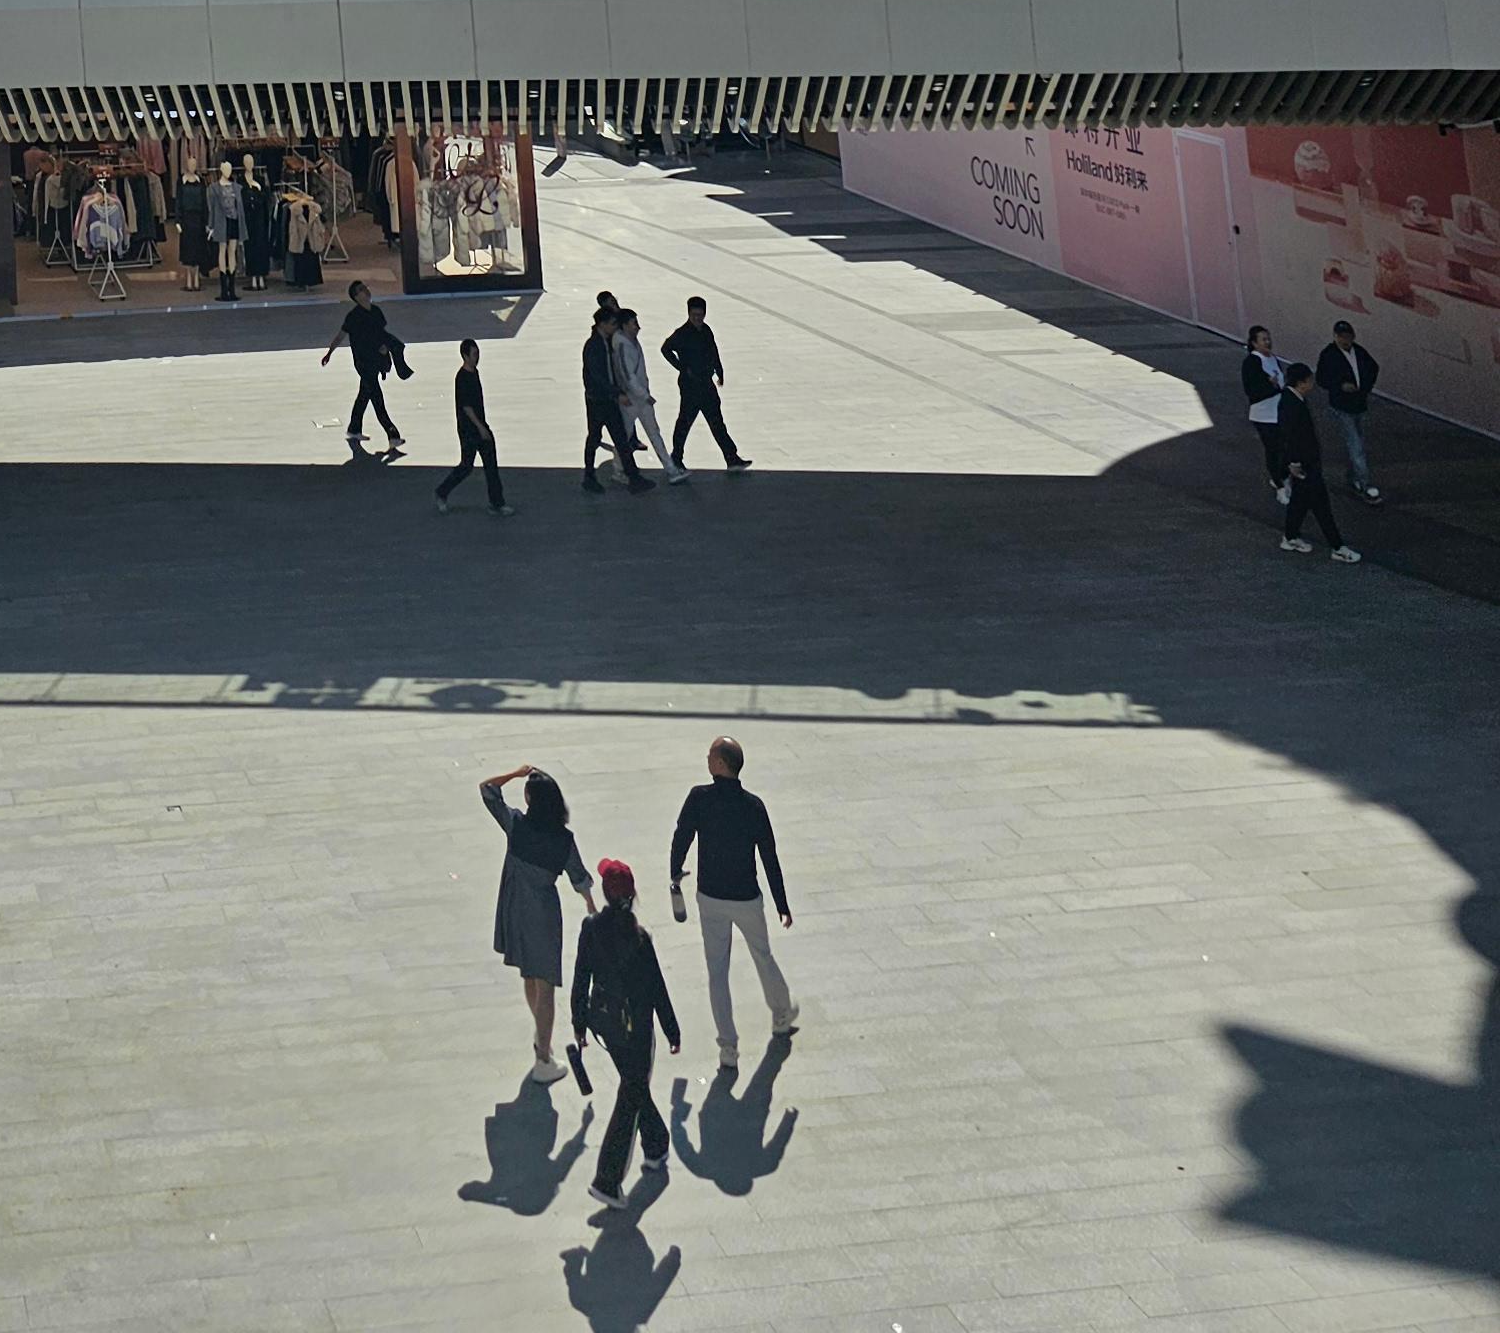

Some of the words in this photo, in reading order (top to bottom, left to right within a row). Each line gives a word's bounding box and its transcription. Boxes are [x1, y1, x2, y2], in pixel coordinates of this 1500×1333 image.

[971, 155, 1041, 205] COMING
[1066, 148, 1113, 183] Holiland
[1114, 163, 1149, 193] 好利来
[993, 195, 1045, 241] SOON
